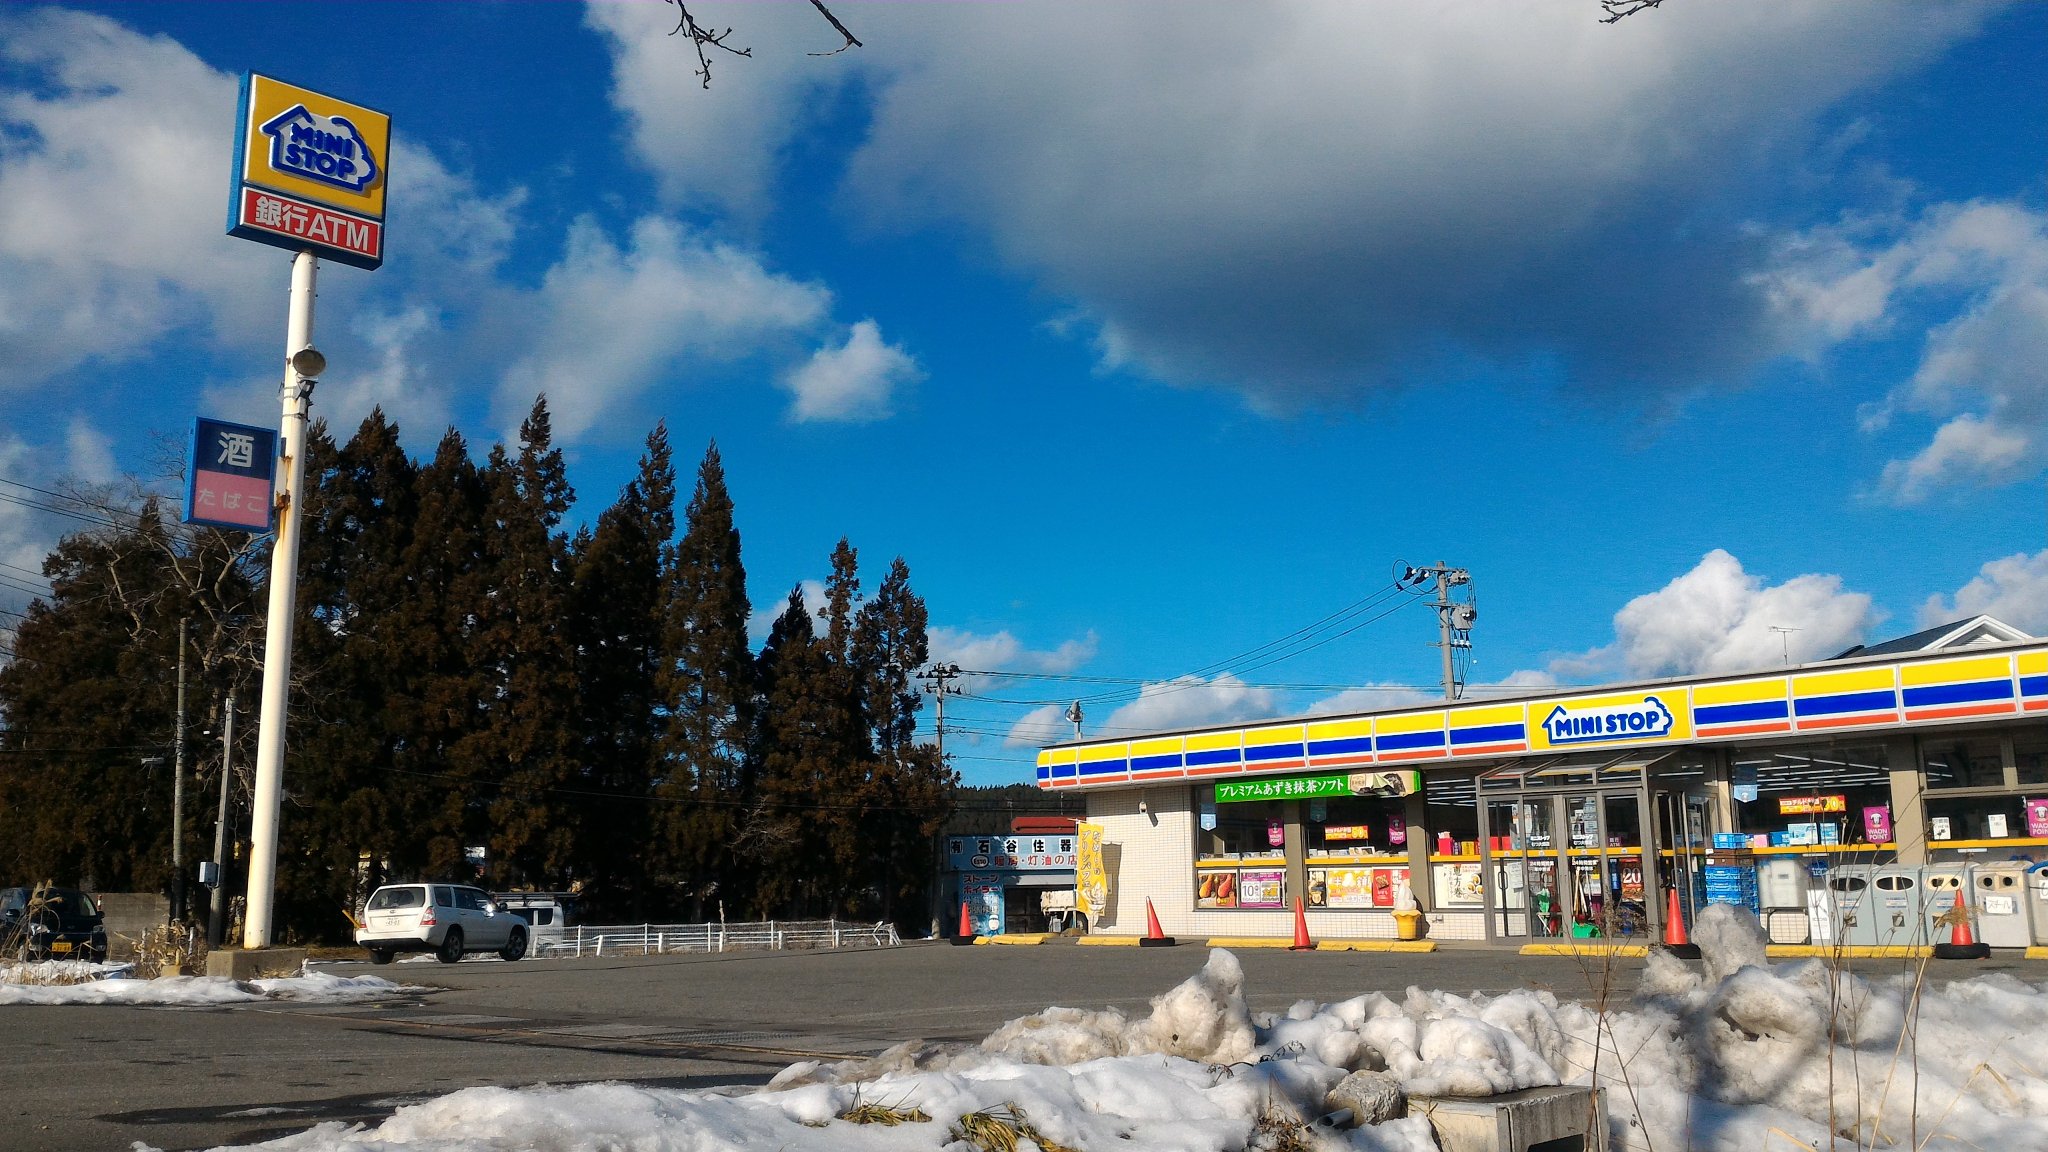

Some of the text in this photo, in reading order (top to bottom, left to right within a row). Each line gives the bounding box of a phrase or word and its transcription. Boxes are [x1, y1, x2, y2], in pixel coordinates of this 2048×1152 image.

[291, 122, 354, 158] MINI
[285, 144, 355, 178] STOP
[255, 196, 369, 251] 銀行ATM
[218, 431, 254, 468] 酒
[198, 488, 264, 513] たばこ
[1555, 711, 1660, 737] MINI STOP
[1220, 779, 1344, 798] プレミアムあずき抹茶ソフト
